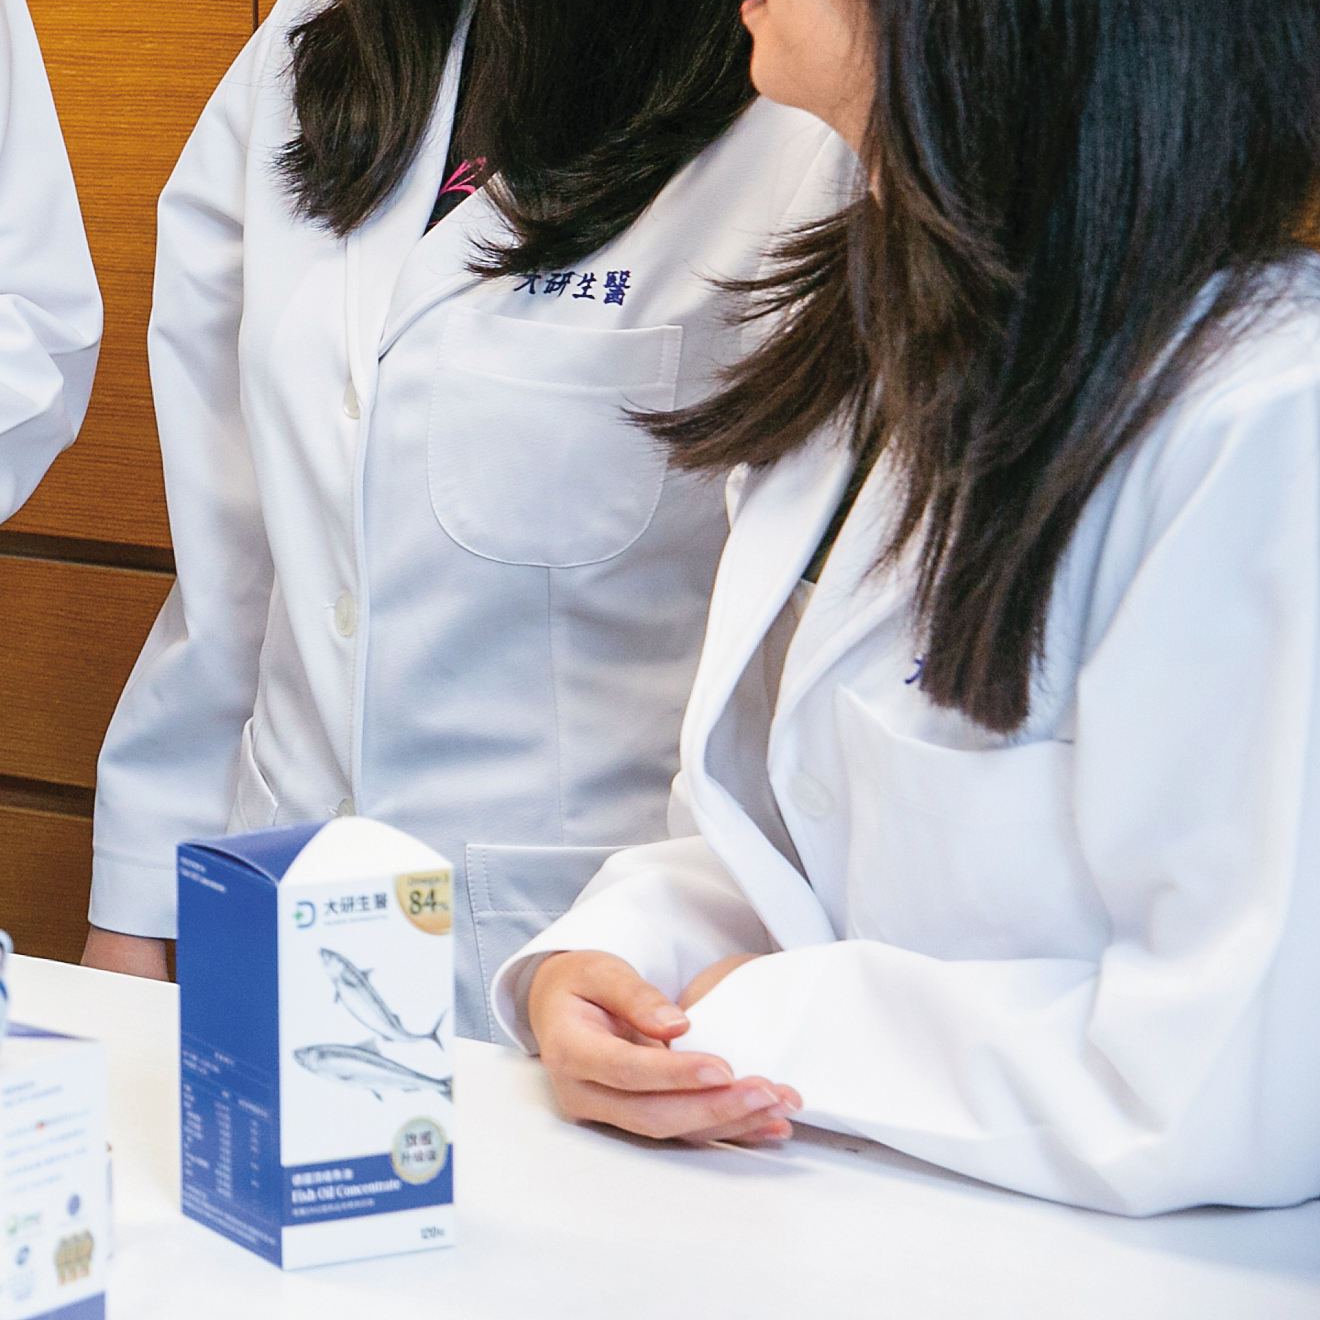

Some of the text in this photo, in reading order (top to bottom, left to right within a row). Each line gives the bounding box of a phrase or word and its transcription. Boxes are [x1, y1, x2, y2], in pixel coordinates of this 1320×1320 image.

[324, 893, 388, 916] 大研生醫
[291, 1179, 402, 1204] Fish Oil Concentrate
